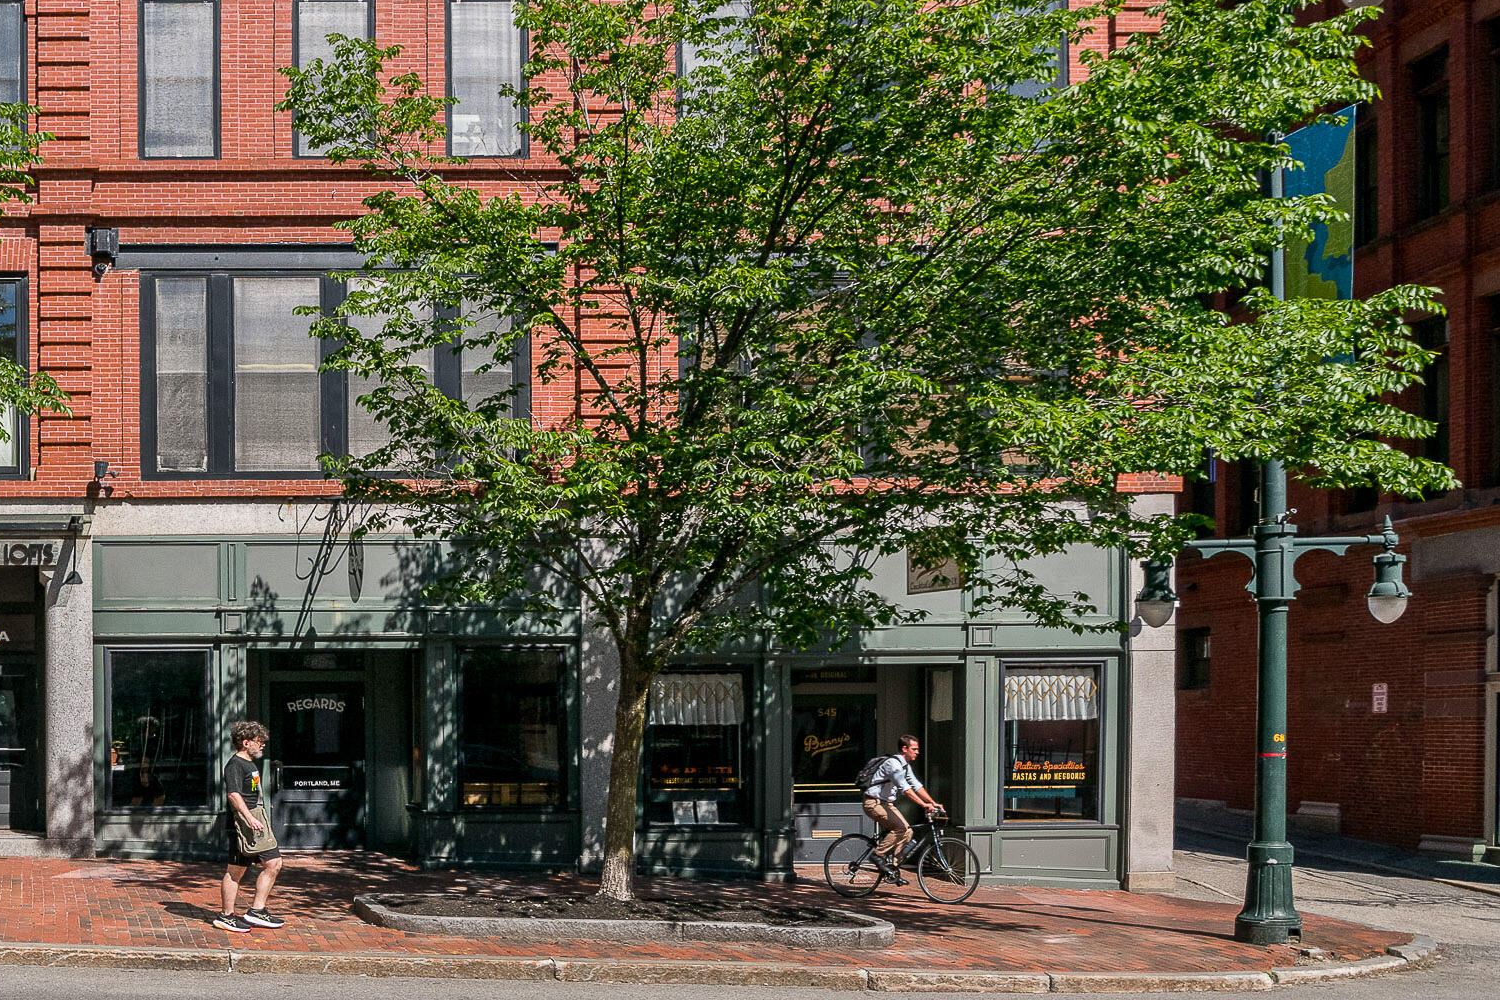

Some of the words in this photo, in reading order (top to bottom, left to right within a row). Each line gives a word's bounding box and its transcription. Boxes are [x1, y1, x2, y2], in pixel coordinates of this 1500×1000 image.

[4, 543, 54, 565] LOFTS
[286, 698, 346, 713] REGARDS
[817, 708, 837, 717] 545
[1012, 772, 1037, 781] PASTAS
